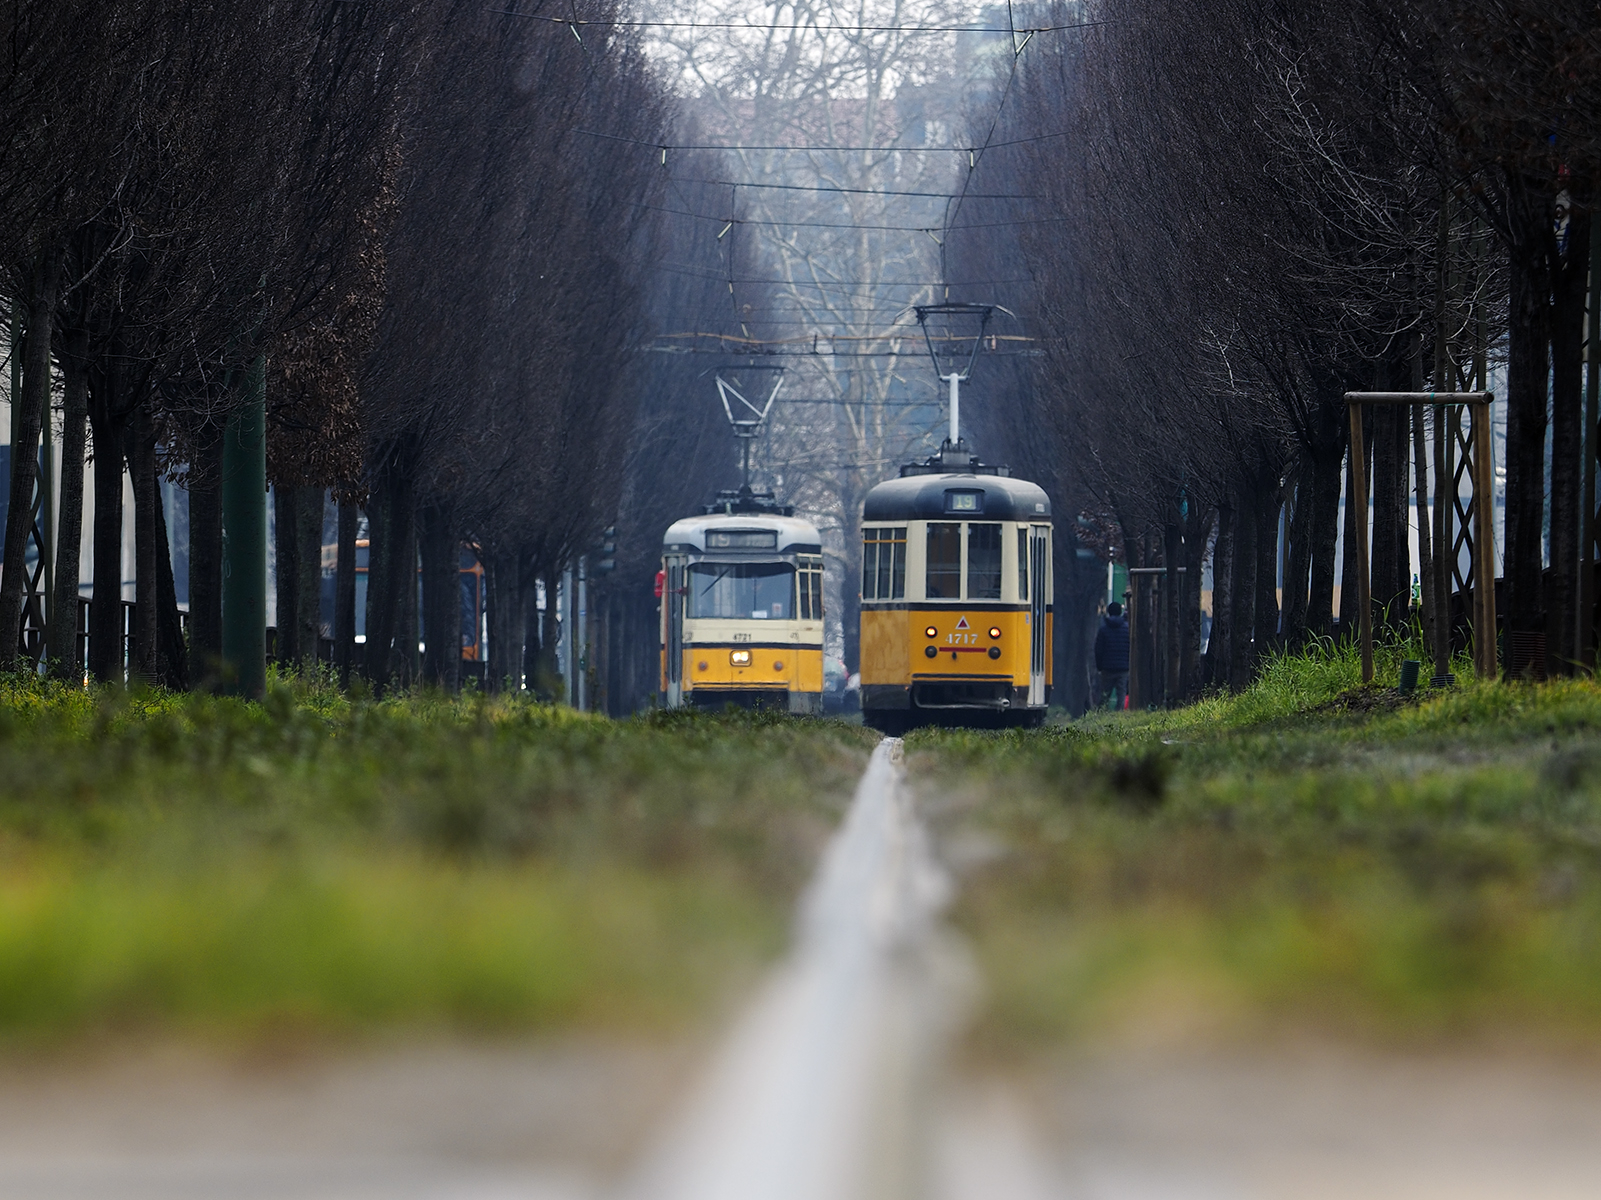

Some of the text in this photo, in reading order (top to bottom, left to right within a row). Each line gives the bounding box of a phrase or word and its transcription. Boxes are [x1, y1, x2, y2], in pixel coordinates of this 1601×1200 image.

[956, 496, 972, 508] 19
[711, 534, 730, 547] 19
[732, 633, 752, 643] 4721
[945, 633, 978, 645] 4717
